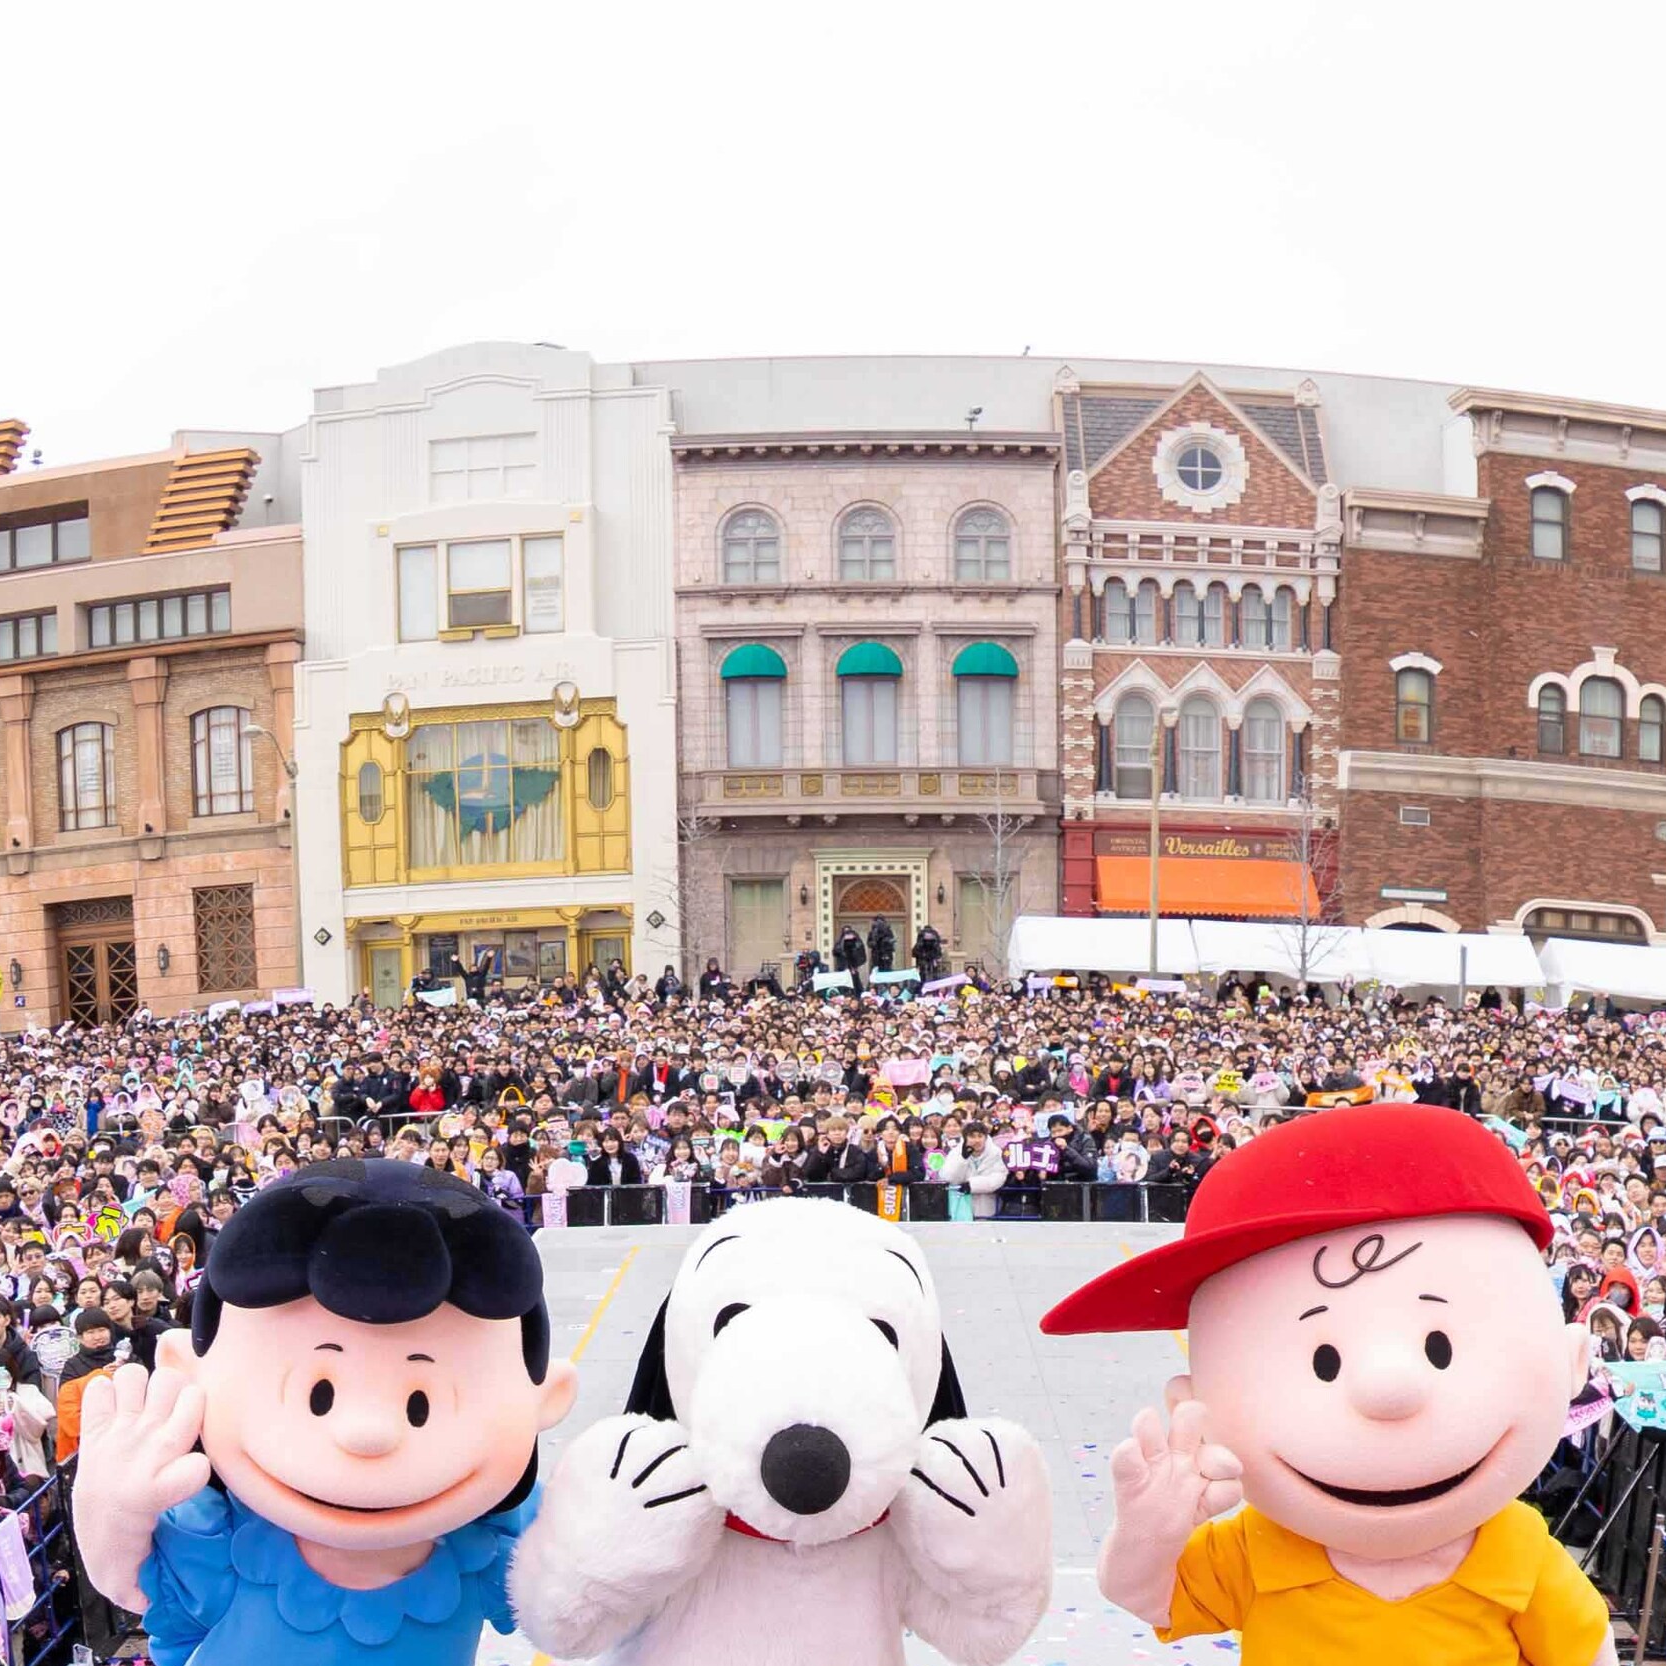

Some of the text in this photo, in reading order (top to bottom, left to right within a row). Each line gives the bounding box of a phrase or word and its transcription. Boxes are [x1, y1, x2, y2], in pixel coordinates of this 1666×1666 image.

[441, 664, 525, 688] PACIFIC
[535, 661, 577, 682] AIR
[1165, 837, 1250, 857] Versailles
[1006, 1143, 1056, 1169] ルナ
